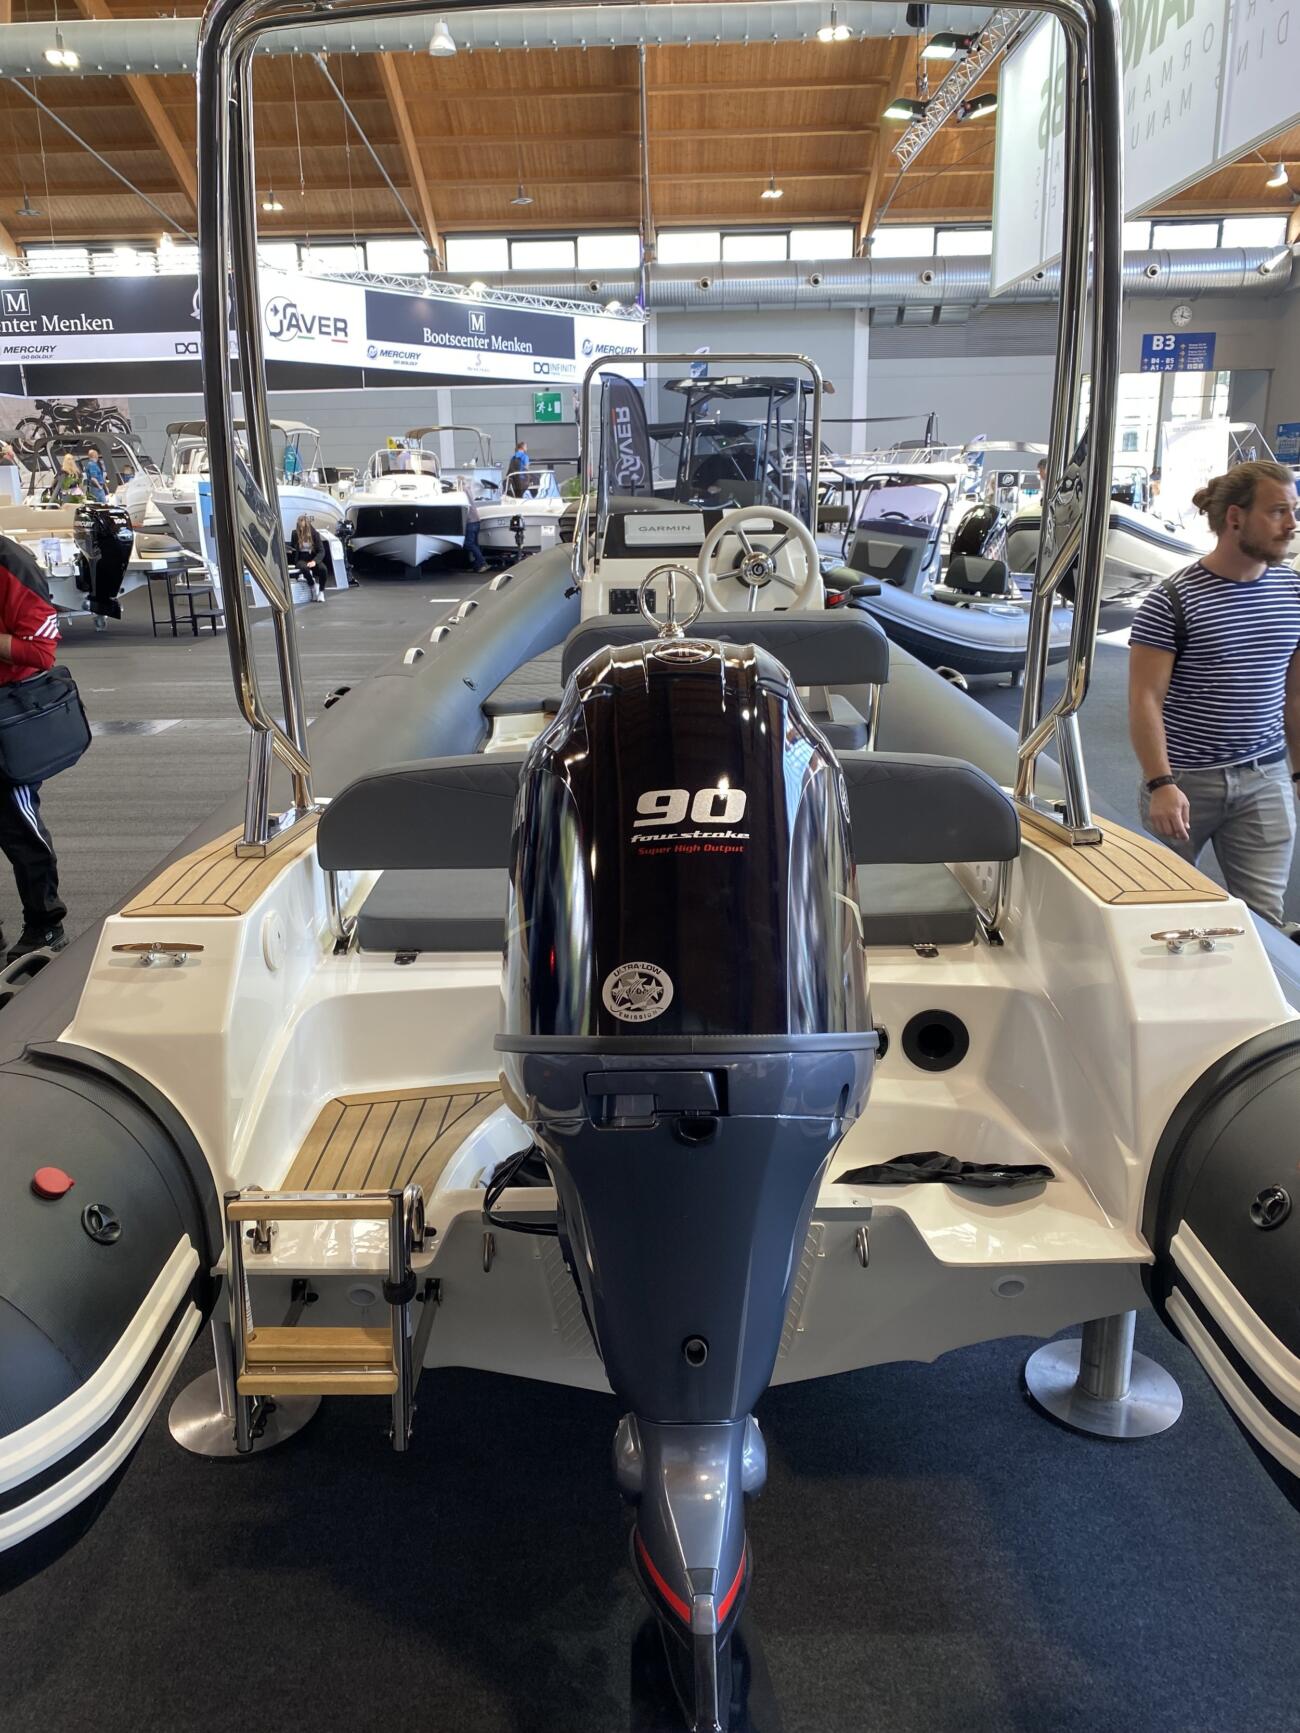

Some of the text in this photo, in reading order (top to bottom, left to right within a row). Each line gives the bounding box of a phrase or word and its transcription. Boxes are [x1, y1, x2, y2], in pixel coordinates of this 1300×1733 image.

[41, 313, 115, 332] Menken
[269, 302, 349, 338] SAVER
[423, 327, 533, 353] Bootscenter Menken
[1152, 335, 1175, 350] B3
[3, 345, 57, 354] MERCURY
[379, 349, 421, 361] MERCURY
[595, 343, 639, 355] MERCURY
[633, 788, 747, 828] 90
[630, 830, 750, 843] fourstroke
[638, 844, 745, 856] Super High Output
[618, 1010, 658, 1020] EMISSION
